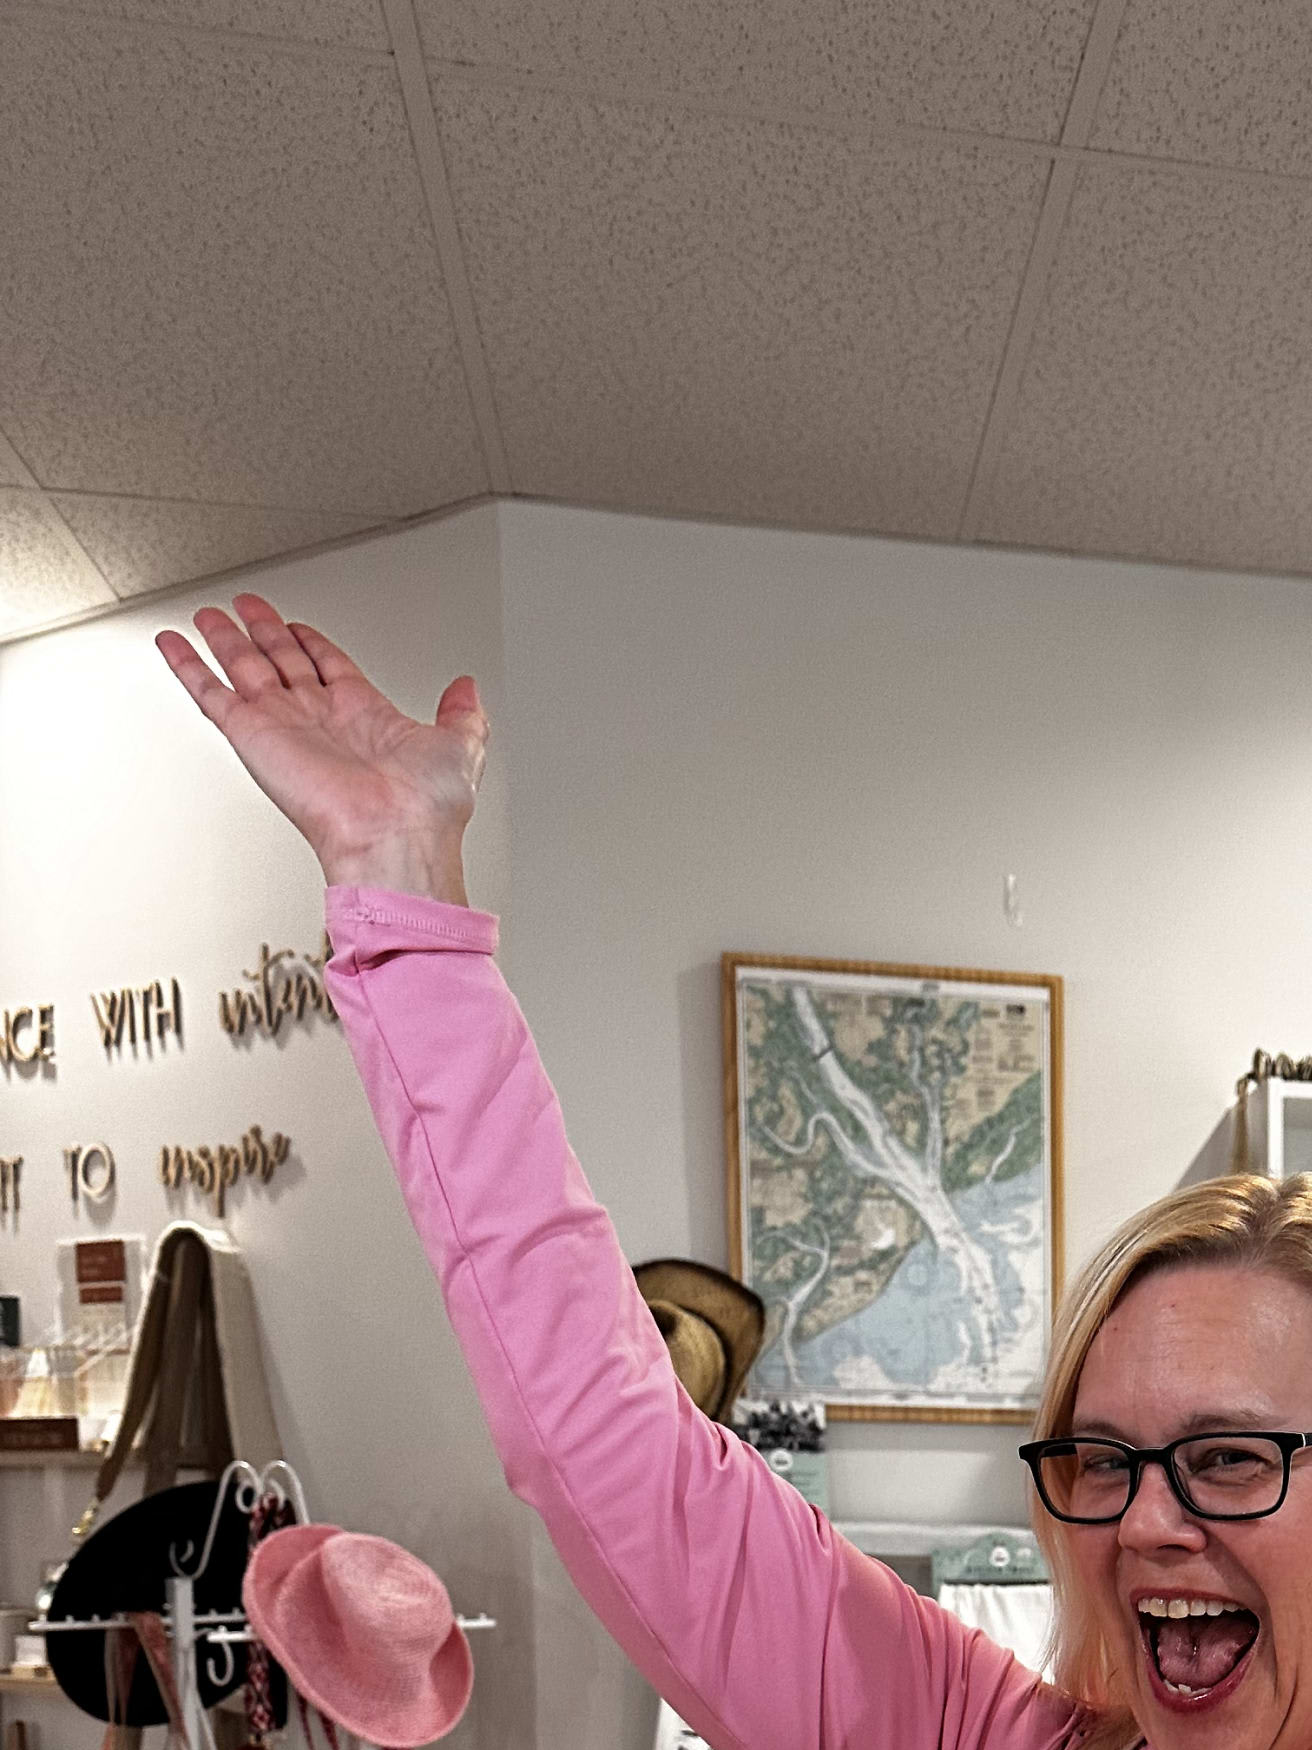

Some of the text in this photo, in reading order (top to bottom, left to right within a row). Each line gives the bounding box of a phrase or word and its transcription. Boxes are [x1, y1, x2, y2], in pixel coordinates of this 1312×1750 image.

[90, 976, 182, 1048] WITH
[63, 1142, 116, 1201] TO
[161, 1124, 292, 1218] inspire
